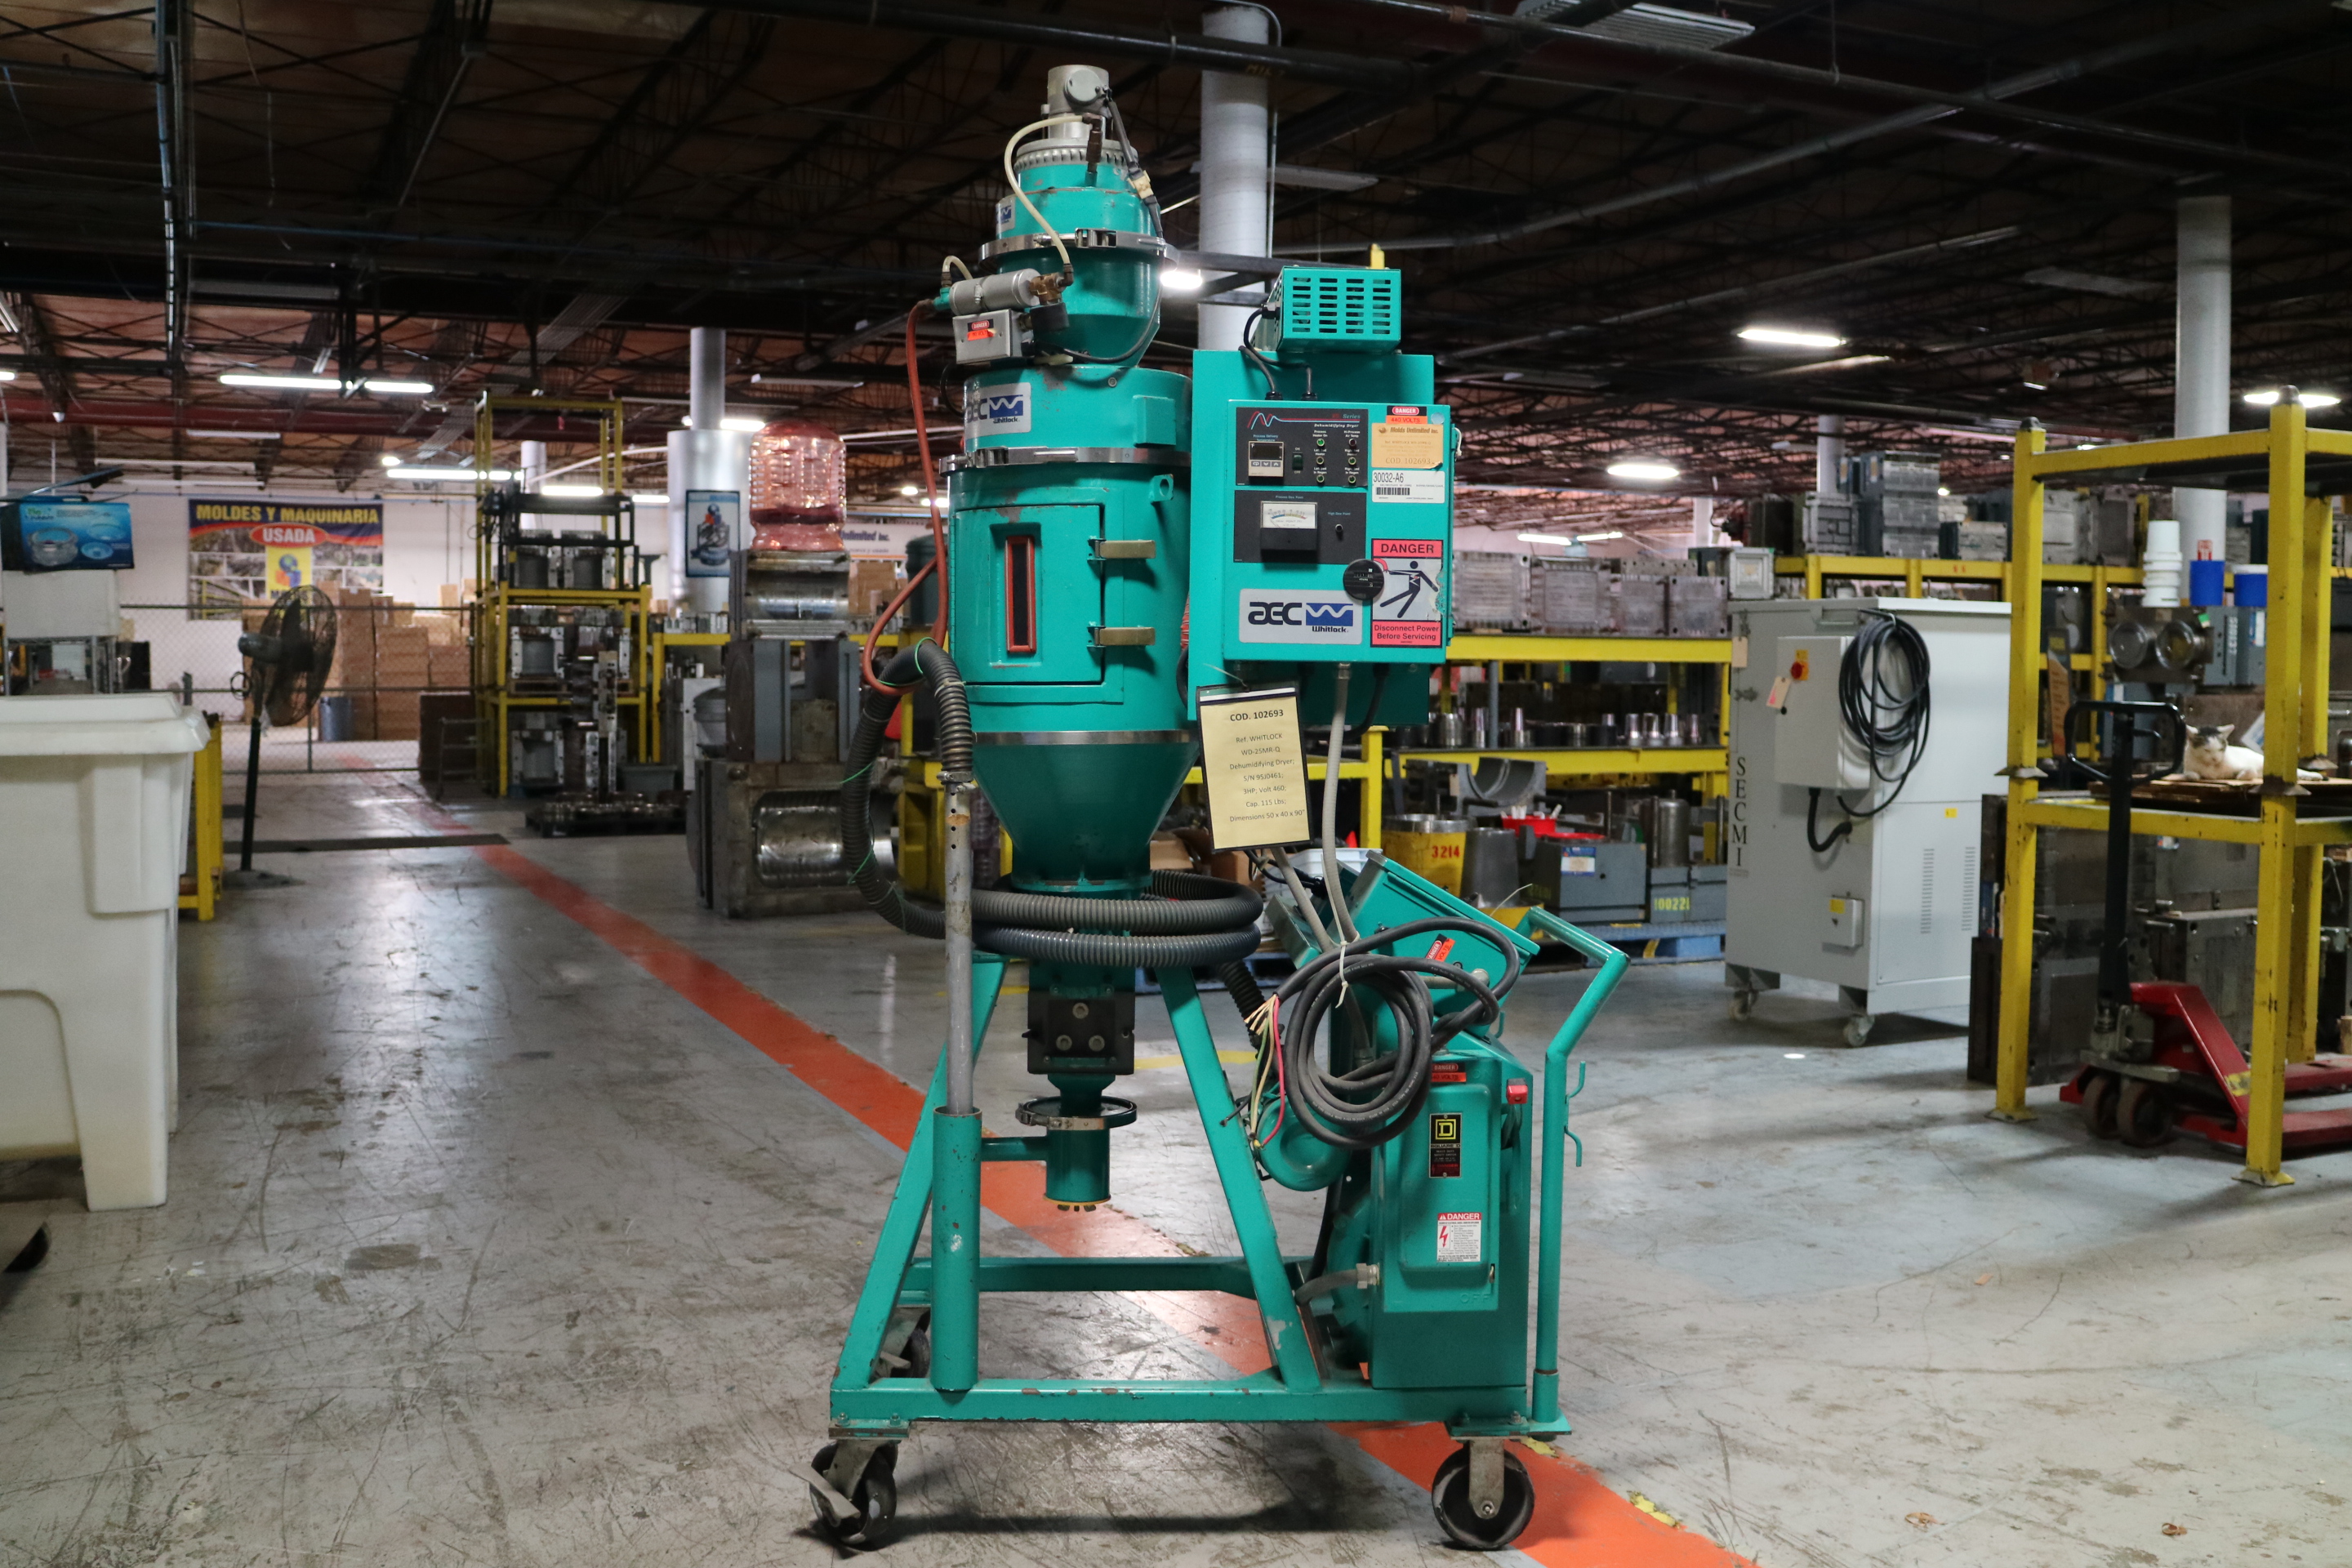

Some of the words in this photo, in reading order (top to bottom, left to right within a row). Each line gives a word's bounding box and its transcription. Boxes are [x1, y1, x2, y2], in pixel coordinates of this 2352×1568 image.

[1373, 472, 1404, 483] 30032-A6
[196, 505, 261, 522] MOLDES
[265, 506, 277, 522] Y
[280, 508, 379, 524] MAQUINARIA
[262, 528, 315, 543] USADA
[1381, 543, 1434, 554] DANGER
[1374, 624, 1414, 632] Disconnect
[1402, 633, 1437, 641] Servicing
[1230, 713, 1251, 722] COD.
[1254, 709, 1284, 719] 102693
[1250, 733, 1283, 742] WHITLOCK
[1241, 746, 1281, 755] WD-25MR-Q
[1229, 760, 1275, 770] Dehumidifying
[1731, 756, 1748, 866] SECMI
[1229, 813, 1265, 822] Dimensions
[1432, 845, 1460, 858] 3214
[1428, 942, 1441, 960] ANGER
[1438, 1122, 1453, 1137] D
